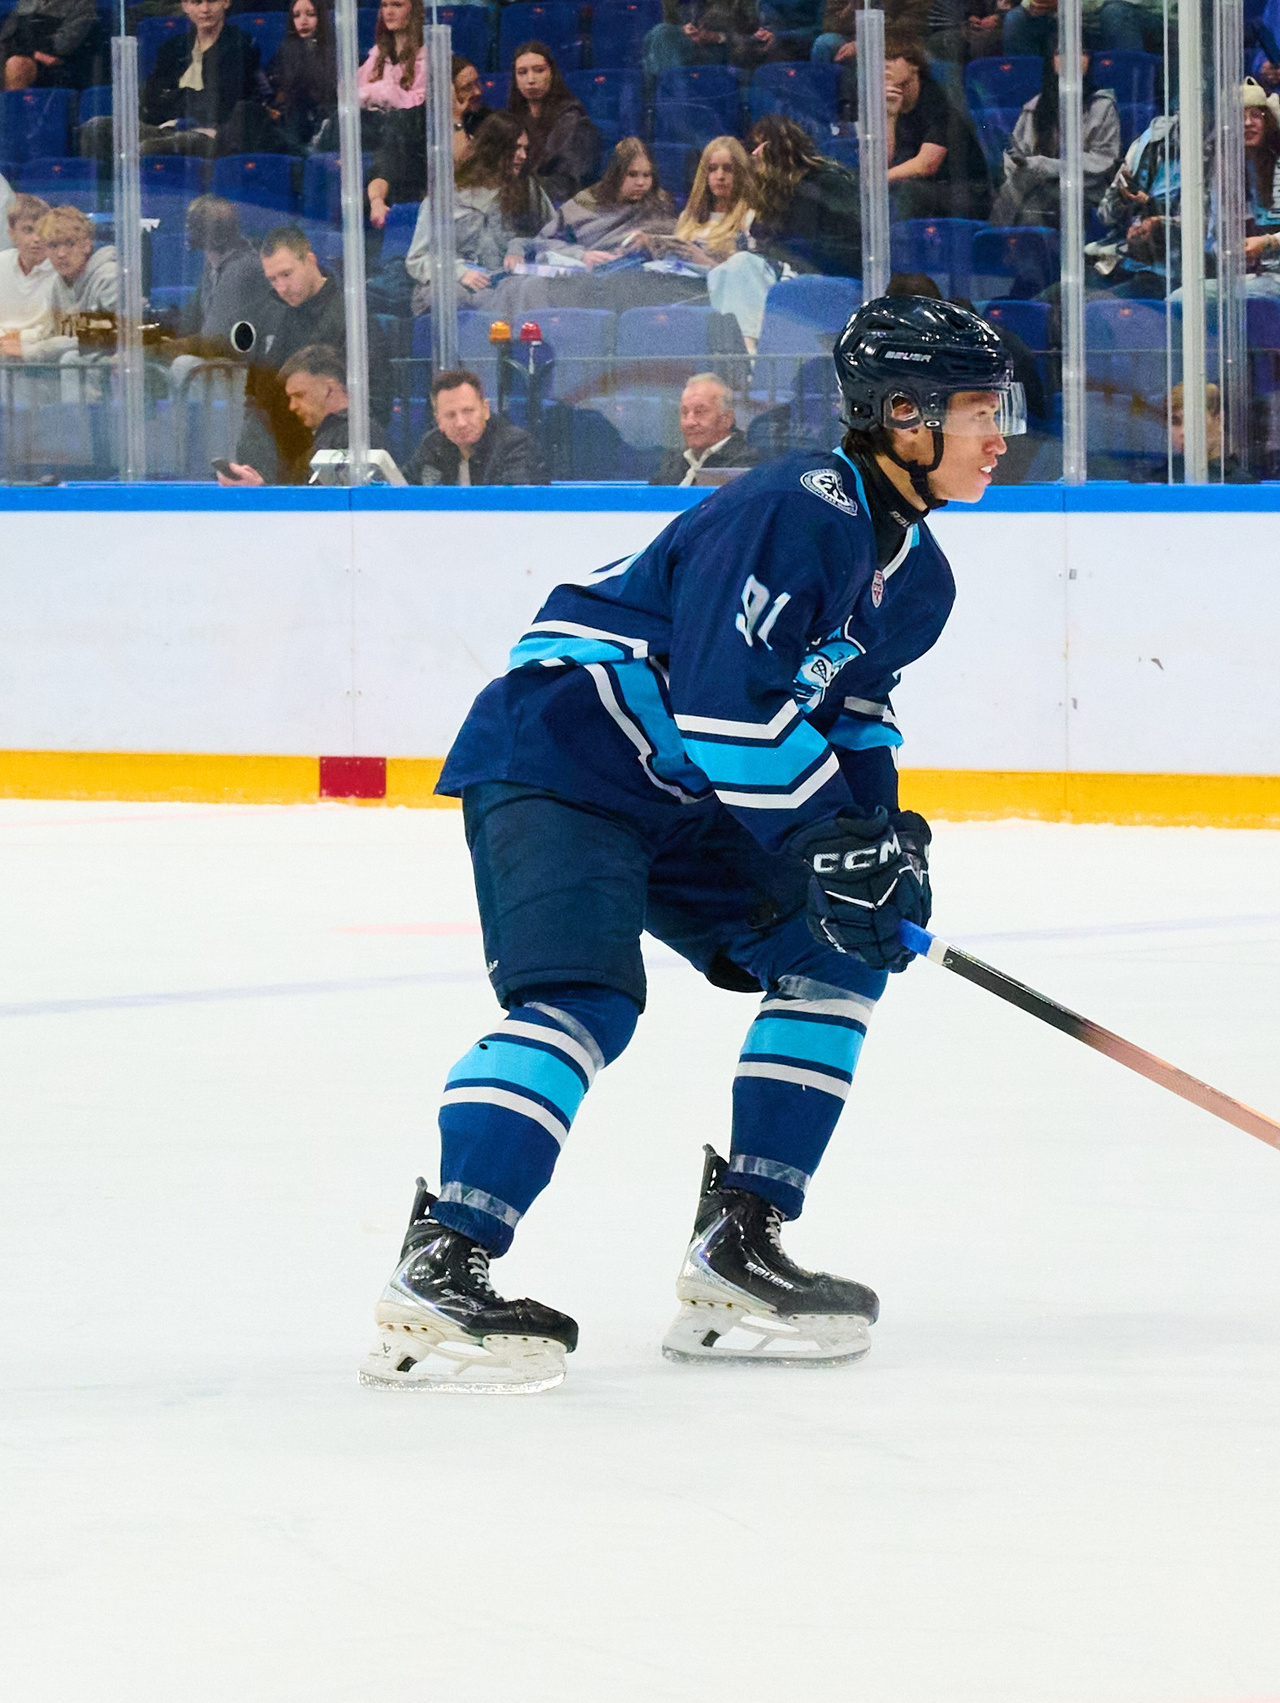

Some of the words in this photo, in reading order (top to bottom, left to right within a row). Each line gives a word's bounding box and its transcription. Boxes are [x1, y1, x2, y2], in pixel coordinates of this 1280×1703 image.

[884, 350, 932, 363] BAUER
[735, 573, 792, 651] 91
[813, 833, 902, 873] CCM
[744, 1260, 794, 1291] BAUER
